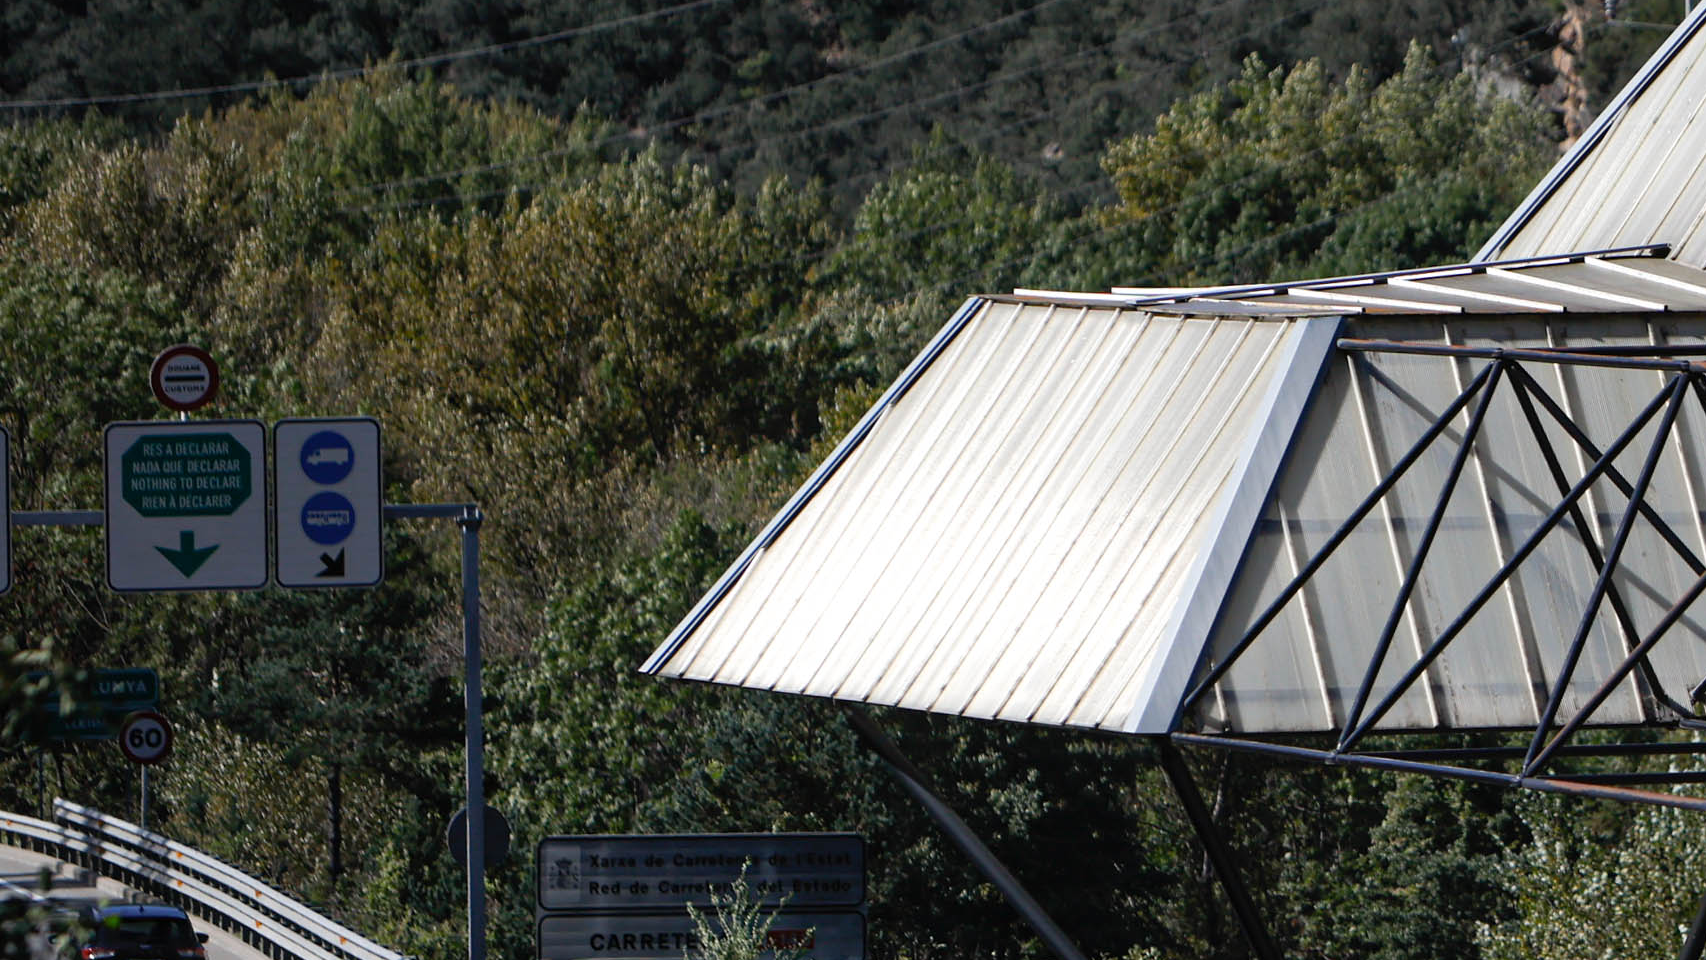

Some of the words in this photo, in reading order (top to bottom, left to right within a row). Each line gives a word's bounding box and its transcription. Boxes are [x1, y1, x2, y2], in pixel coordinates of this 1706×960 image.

[143, 442, 163, 456] RES
[165, 442, 174, 456] A
[176, 441, 230, 456] DECLARAR
[132, 460, 161, 473] NADA
[162, 460, 182, 473] QUE
[187, 459, 240, 472] DECLARAR
[131, 477, 177, 490] NOTHING
[180, 477, 193, 490] TO
[196, 475, 241, 489] DECLARE
[142, 495, 167, 508] RIEN
[129, 728, 162, 748] 60
[589, 854, 637, 868] Xarxa
[644, 853, 665, 867] de
[589, 881, 621, 894] Red
[630, 880, 649, 894] de
[757, 879, 783, 893] del
[793, 879, 851, 893] Estado
[590, 932, 714, 951] CARRETE
